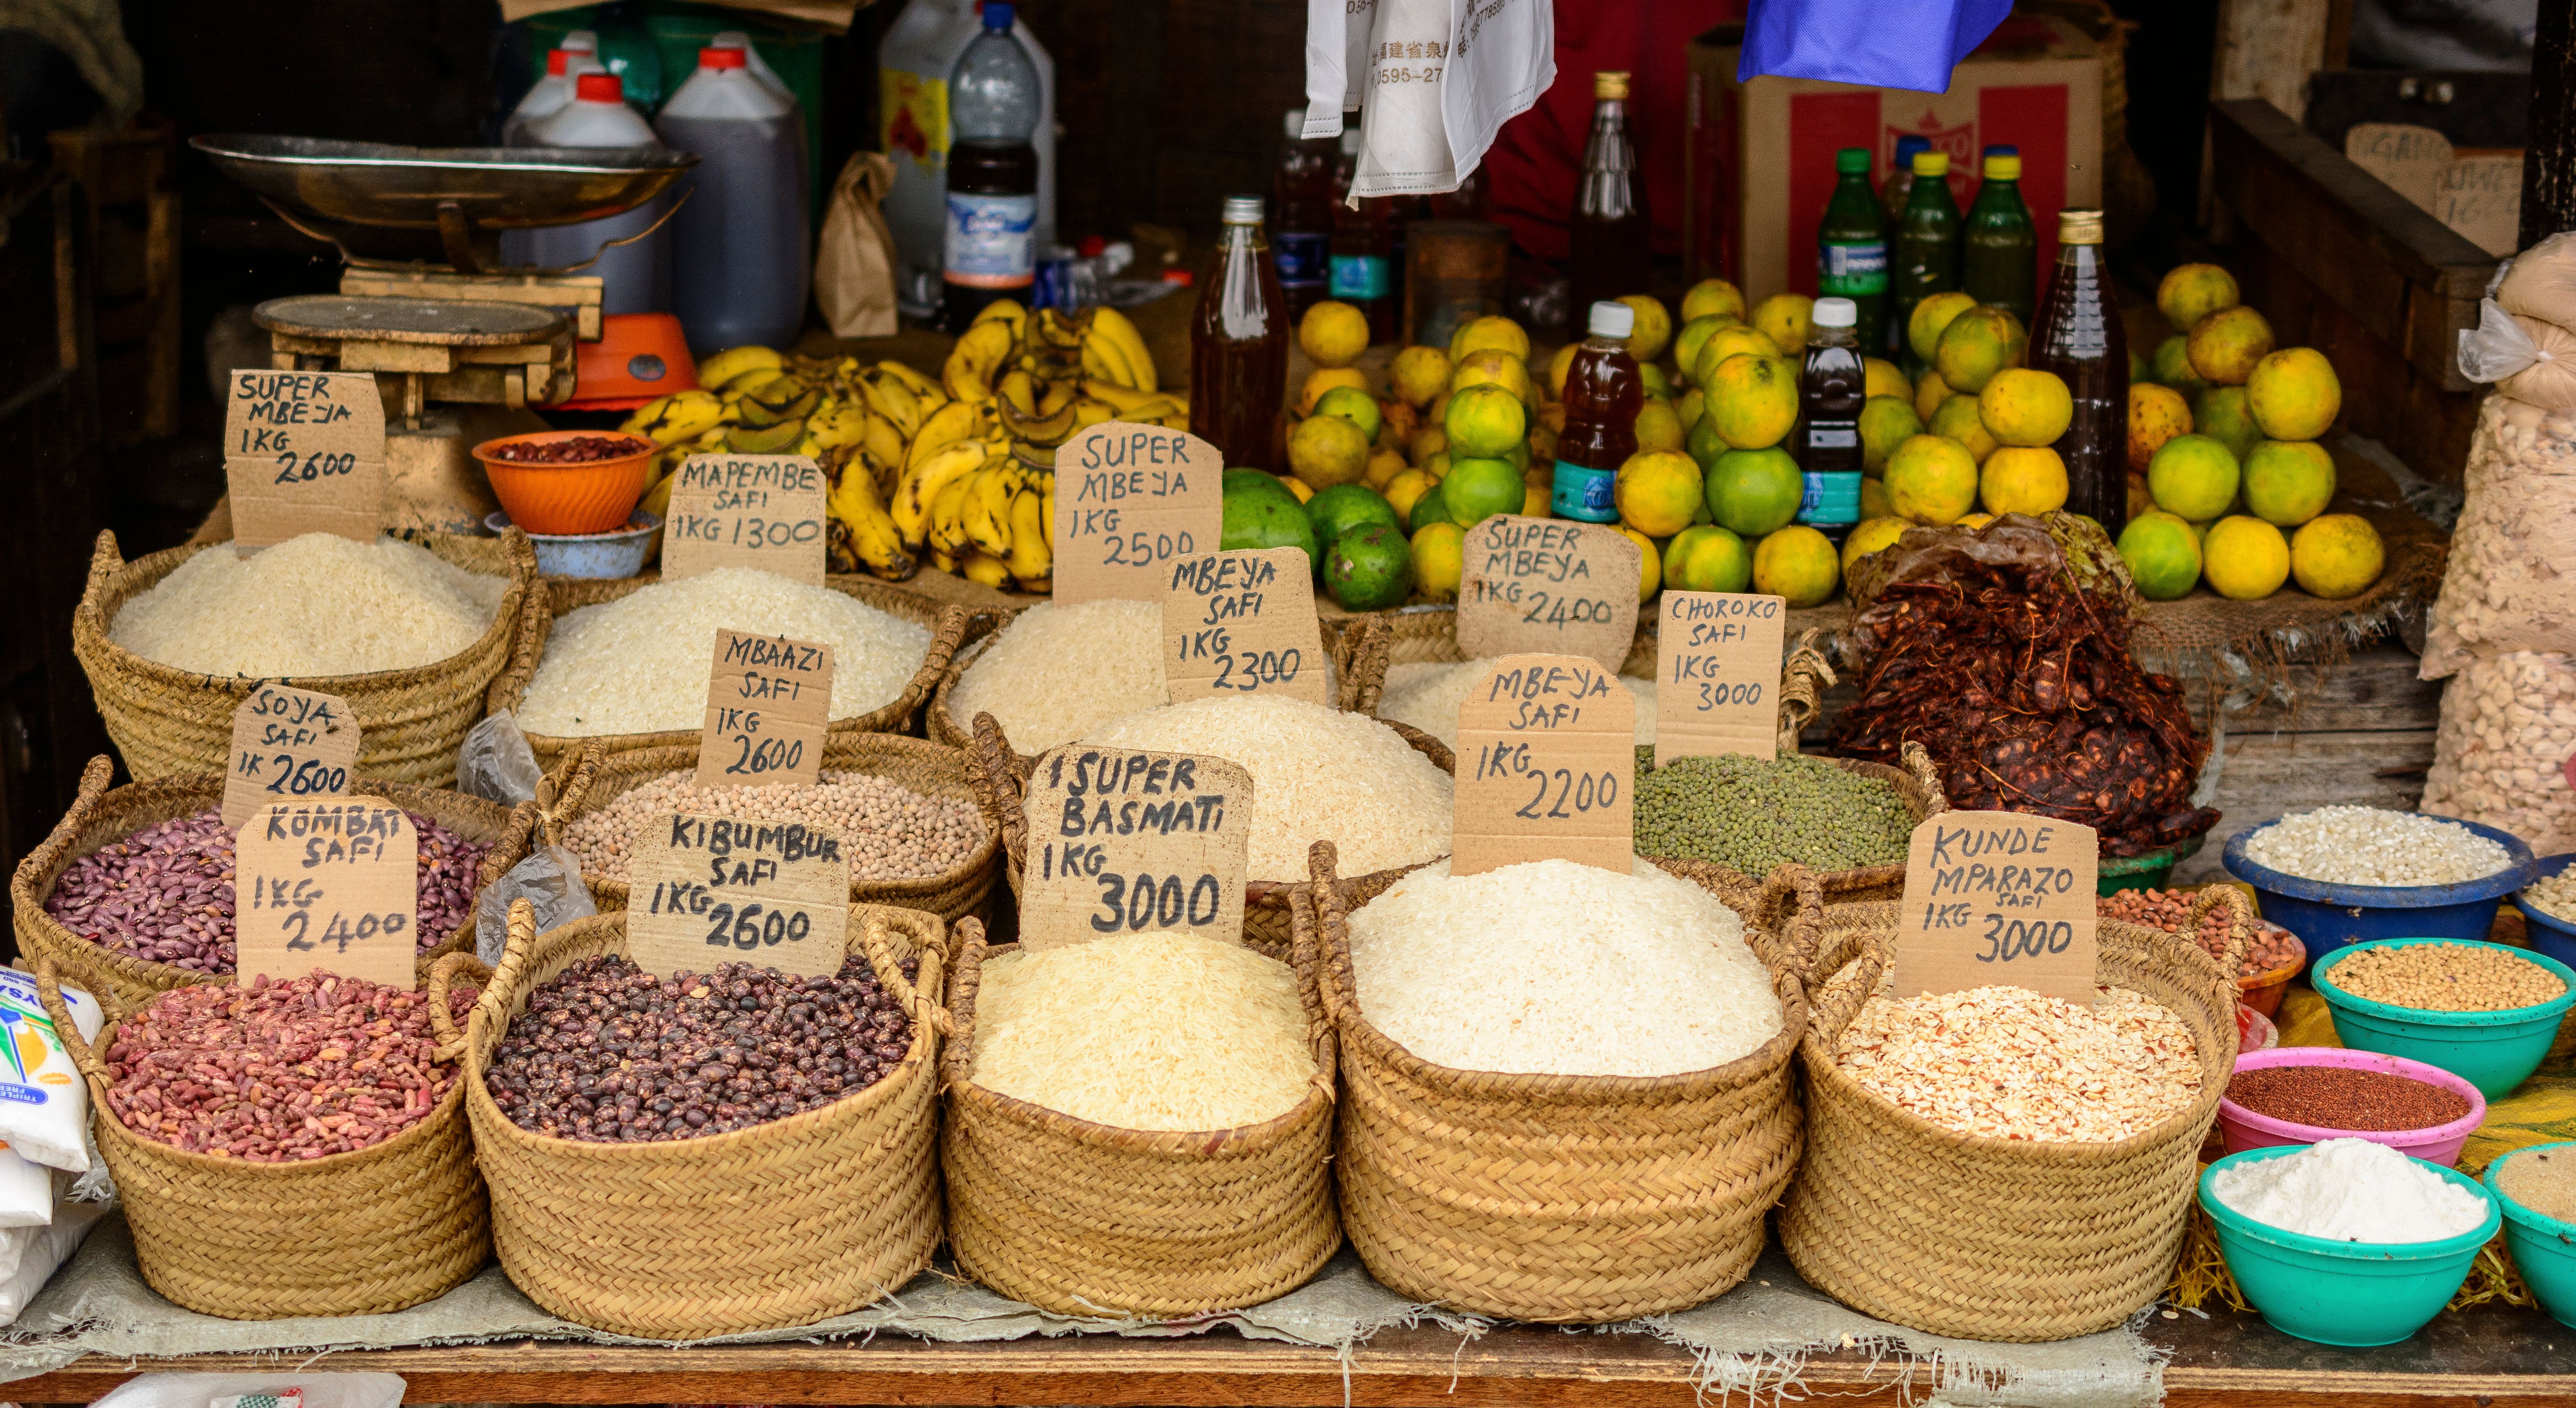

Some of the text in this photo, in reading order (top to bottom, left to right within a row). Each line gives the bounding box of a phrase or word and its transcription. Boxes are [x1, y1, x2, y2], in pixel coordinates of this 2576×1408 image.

[237, 375, 330, 401] SUPER
[241, 428, 291, 453] 1KG
[1081, 432, 1190, 470] SUPER
[275, 451, 356, 485] 2600
[682, 461, 817, 491] MAPEMBE
[713, 489, 768, 511] SAFI
[733, 517, 820, 549] 1300
[1070, 509, 1121, 539] 1KG
[1485, 517, 1583, 551] SUPER
[1103, 530, 1194, 567] 2500
[1172, 556, 1278, 596] MBEYA
[1484, 549, 1590, 583] MBEYA
[1203, 592, 1264, 626] SAFI
[1522, 591, 1613, 631] 2400
[1672, 597, 1777, 621] CHOROKO
[1180, 627, 1231, 662] 1KG
[1688, 623, 1746, 647] SAFI
[724, 635, 824, 672] MBAAZI
[1212, 647, 1301, 692] 2300
[1674, 654, 1721, 685] 1KG
[738, 671, 800, 701] SAFI
[1489, 666, 1611, 702] MBEYA
[1697, 682, 1762, 712] 3000
[252, 689, 338, 726] SOYA
[717, 707, 760, 735] 1KG
[1508, 701, 1580, 730] SAFI
[260, 723, 317, 747] SAFI
[725, 734, 803, 775] 2600
[265, 754, 346, 796] 2600
[1515, 768, 1618, 820] 2200
[1060, 794, 1225, 837] BASMATI
[301, 835, 384, 869] SAFI
[670, 814, 841, 863] KIBUMBUR
[1930, 825, 2054, 869] KUNDE
[709, 856, 778, 888] SAFI
[1043, 842, 1109, 881] 1KG
[254, 874, 325, 910] 1KG
[1930, 863, 2074, 896] MPARAZO
[649, 880, 715, 915] 1KG
[1090, 872, 1220, 933] 3000
[1996, 892, 2042, 909] SAFI
[282, 909, 407, 954] 2400
[705, 902, 811, 951] 2600
[1923, 902, 2073, 963] 1KG 3000
